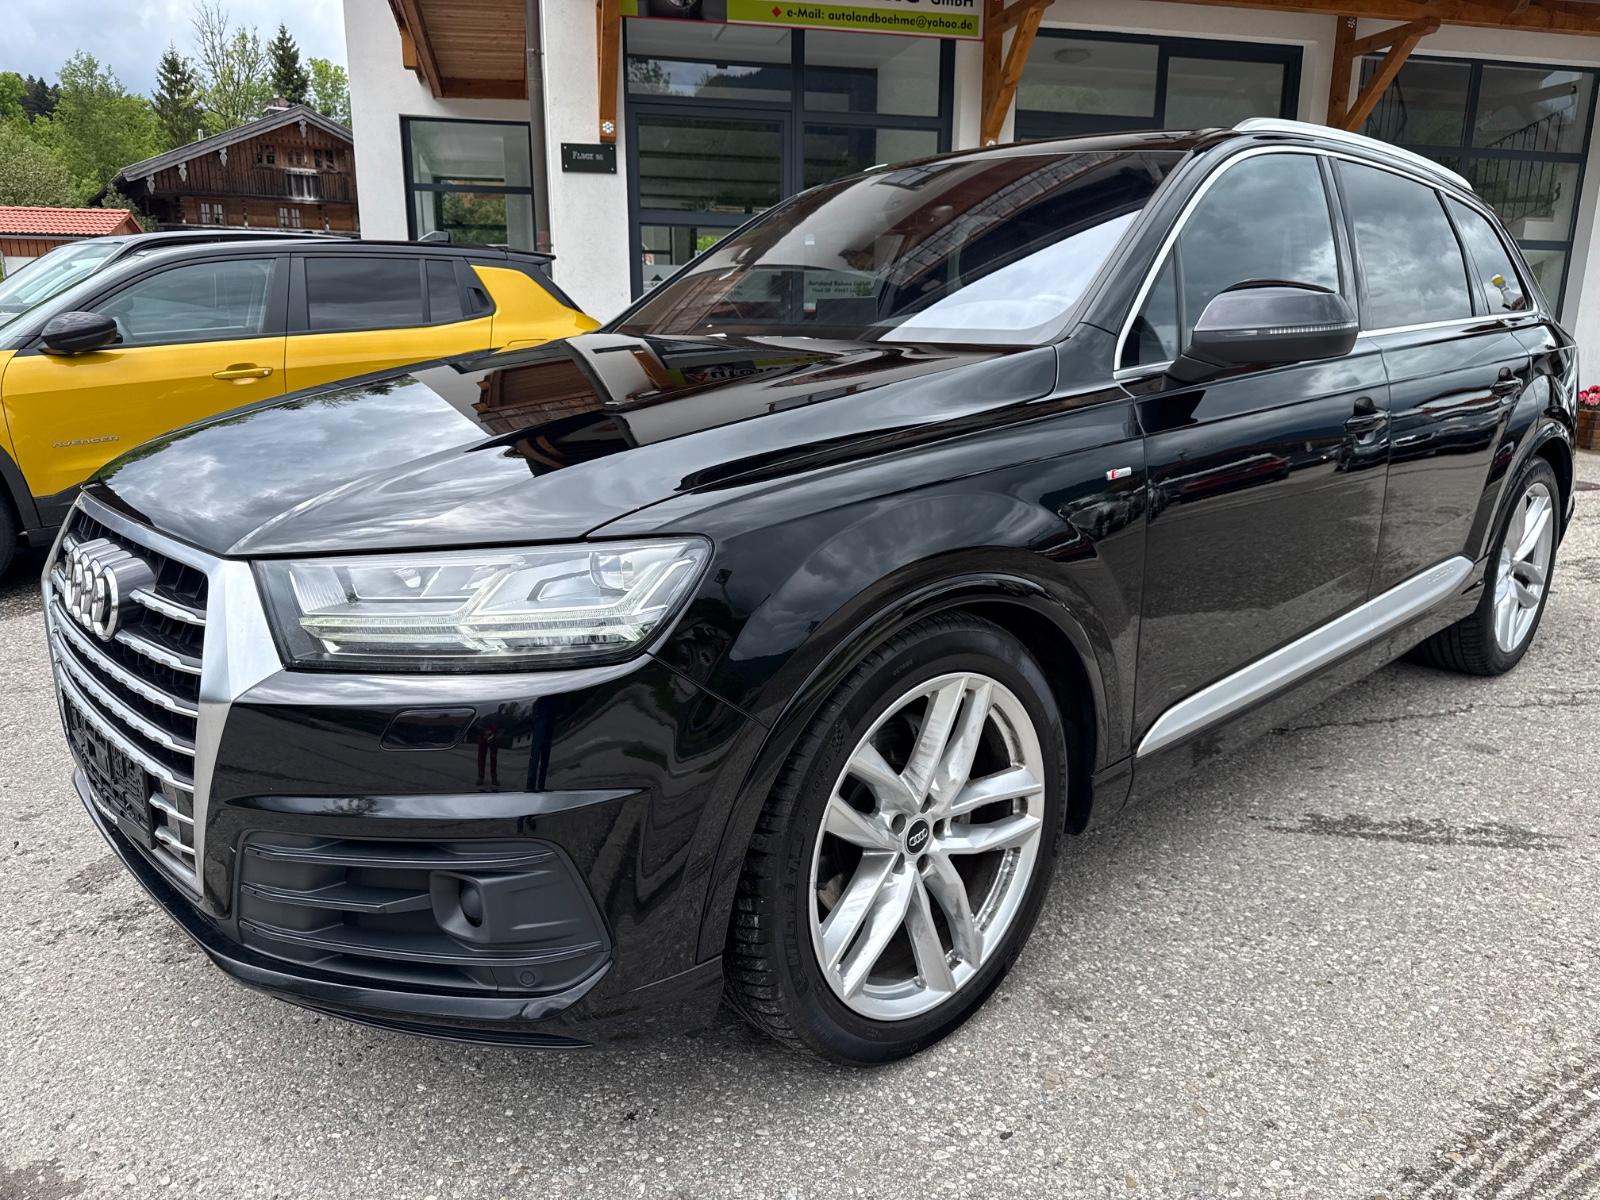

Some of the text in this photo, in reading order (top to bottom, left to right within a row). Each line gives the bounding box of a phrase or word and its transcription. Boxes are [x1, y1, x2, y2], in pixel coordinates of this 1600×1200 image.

[786, 8, 973, 30] e-Mail: autolandboehme@yahoo.de
[52, 435, 119, 448] AVENGER
